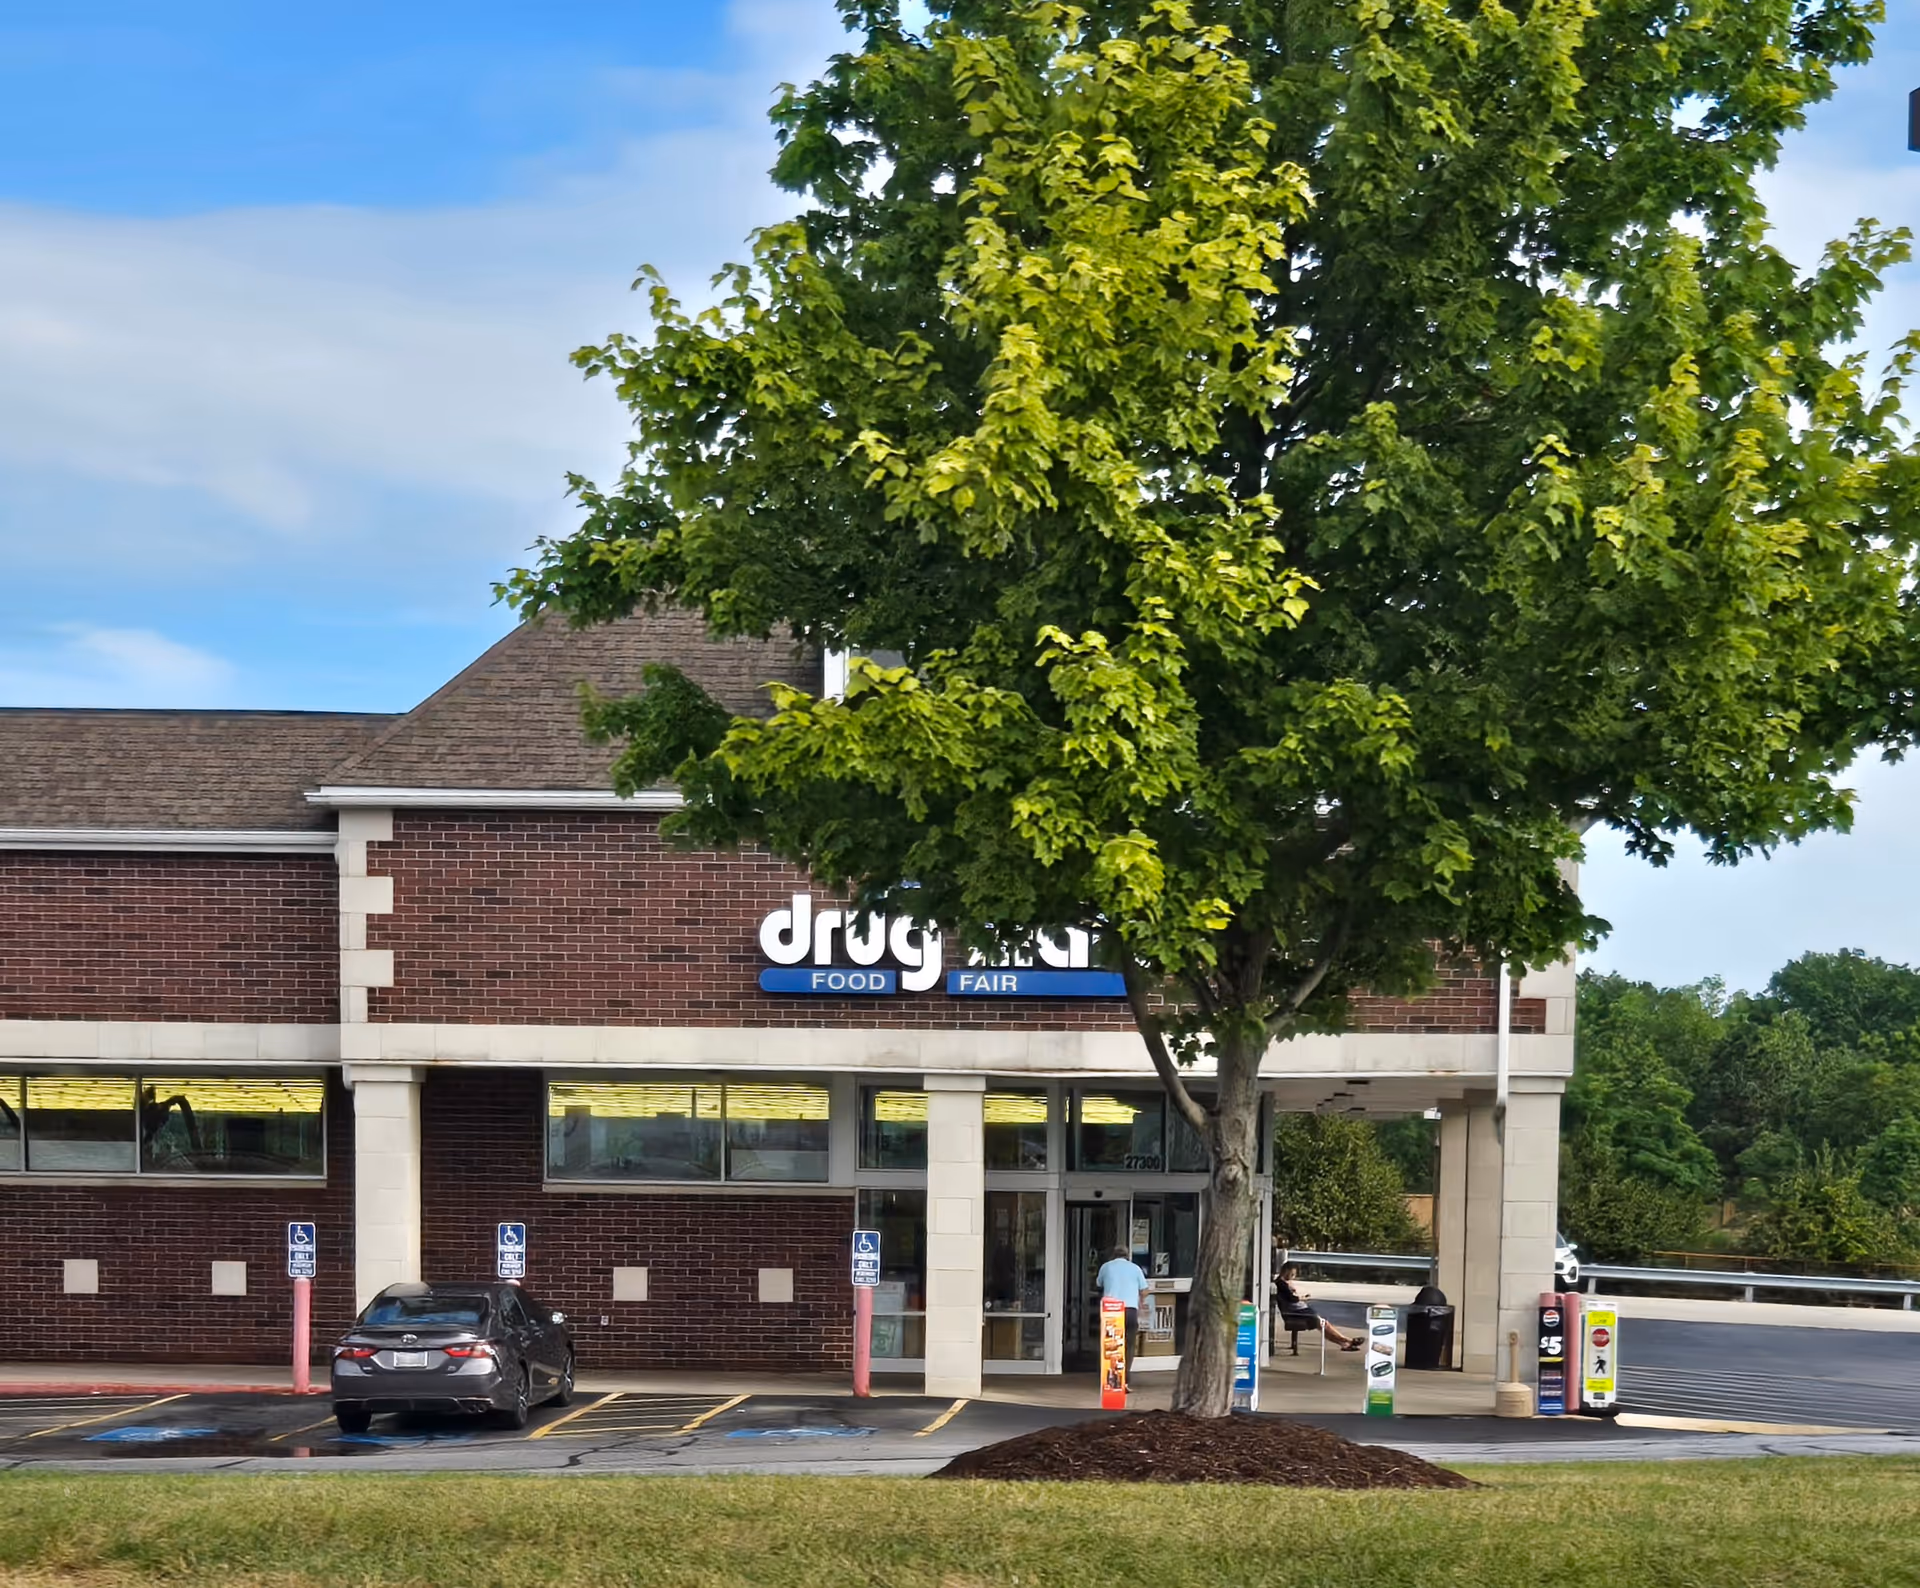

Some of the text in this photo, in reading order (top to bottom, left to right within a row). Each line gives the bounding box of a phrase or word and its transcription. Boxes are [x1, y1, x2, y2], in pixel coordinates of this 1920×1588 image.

[759, 894, 943, 992] drug
[812, 973, 1017, 992] FOOD FAIR
[1539, 1336, 1562, 1355] $5
